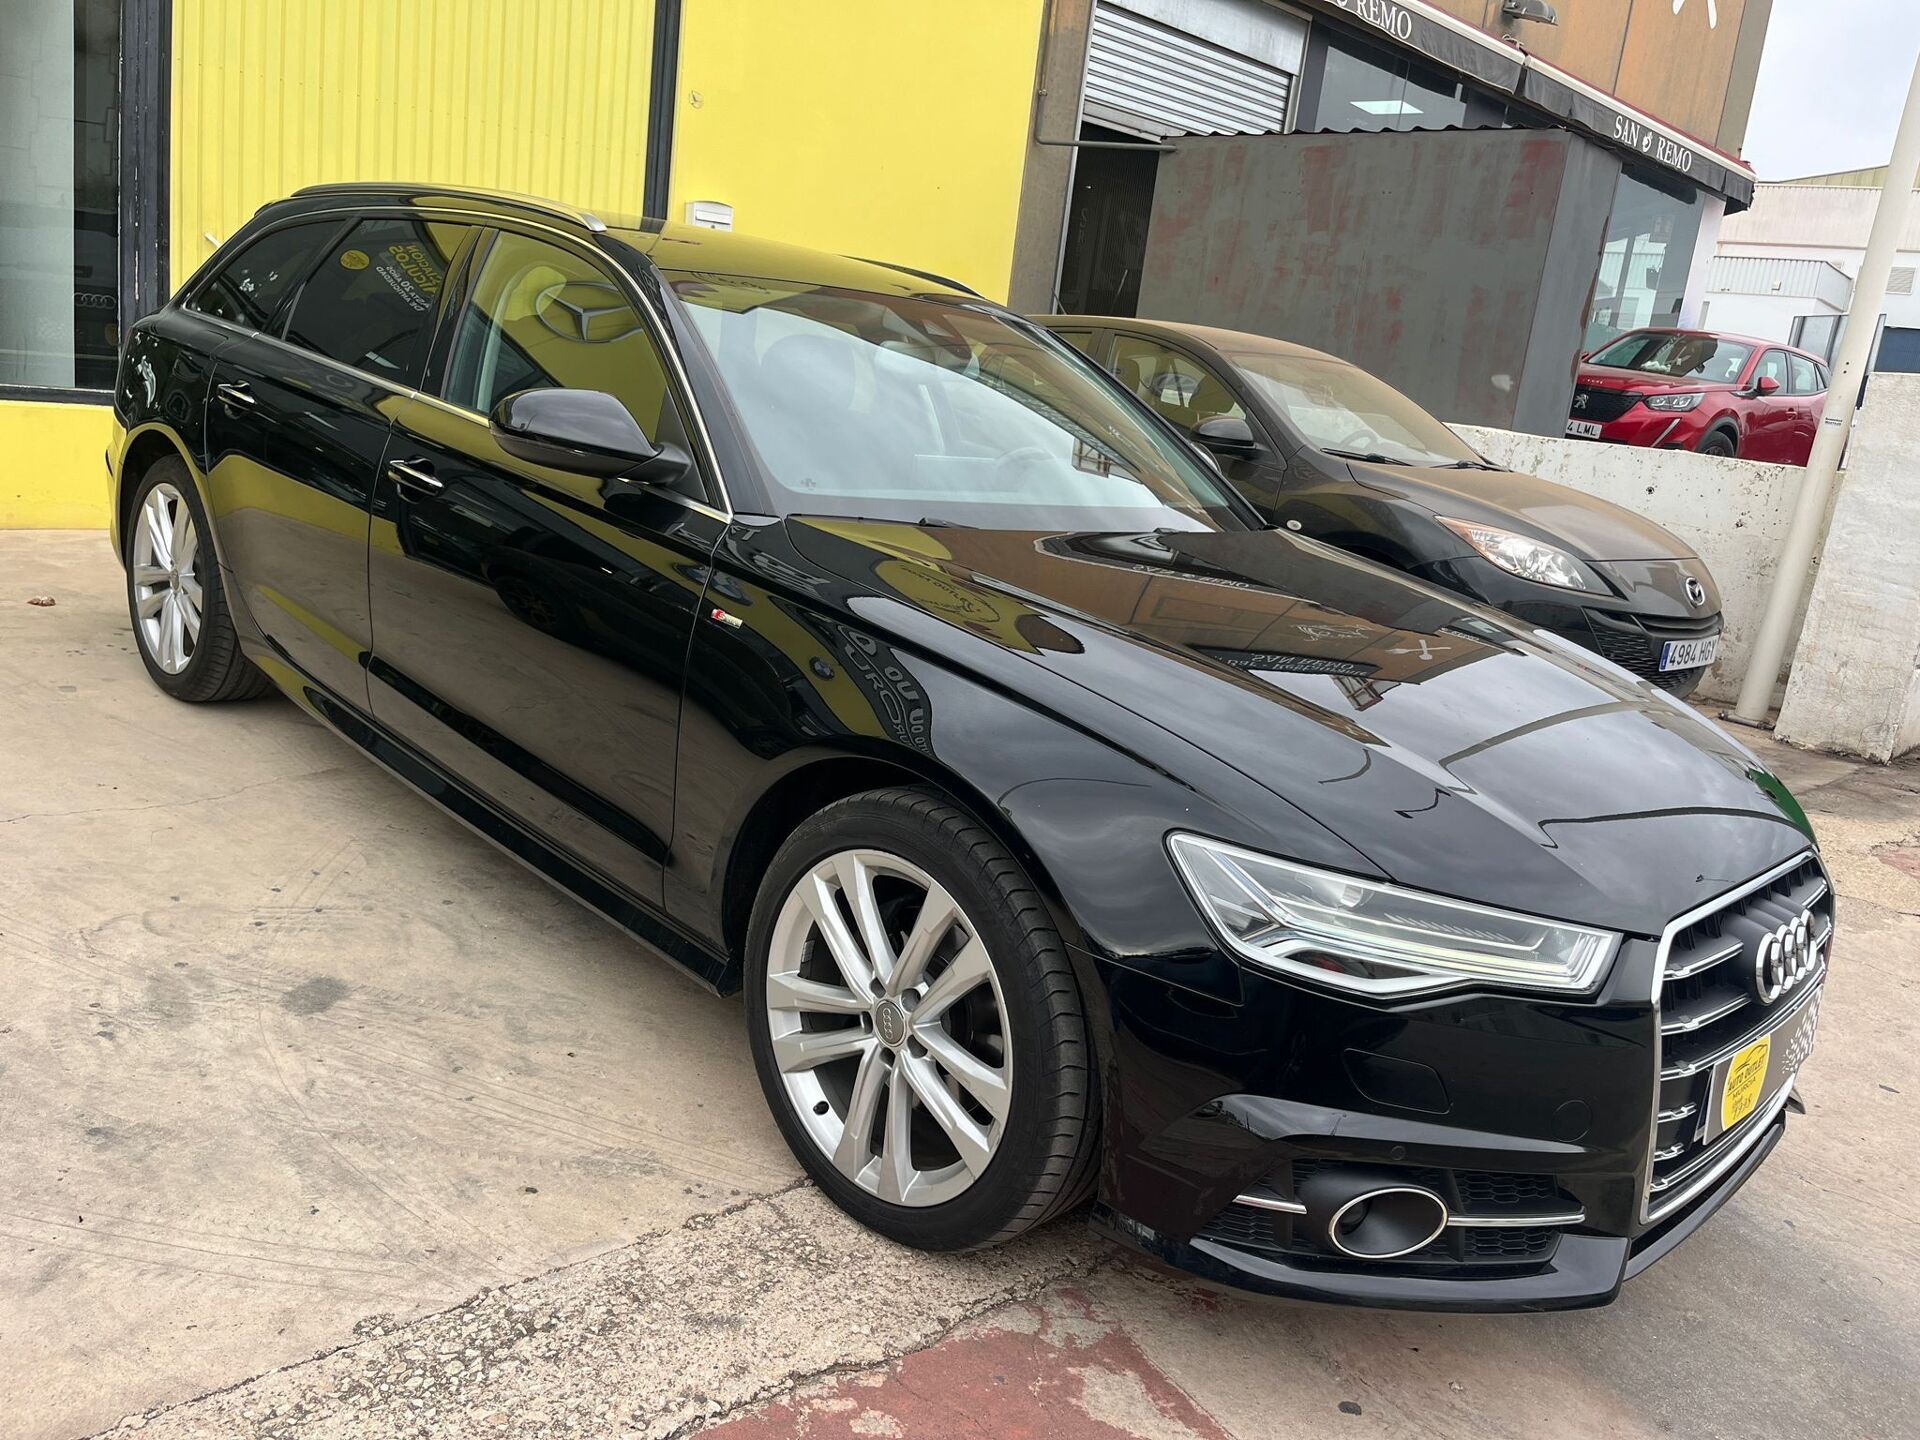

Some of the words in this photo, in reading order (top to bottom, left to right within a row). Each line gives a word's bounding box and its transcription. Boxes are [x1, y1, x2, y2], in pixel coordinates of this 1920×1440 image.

[1613, 115, 1640, 147] SAN
[1656, 137, 1692, 172] REMO
[1576, 423, 1596, 436] LML
[1669, 644, 1698, 665] 4984
[1698, 639, 1716, 662] HGY
